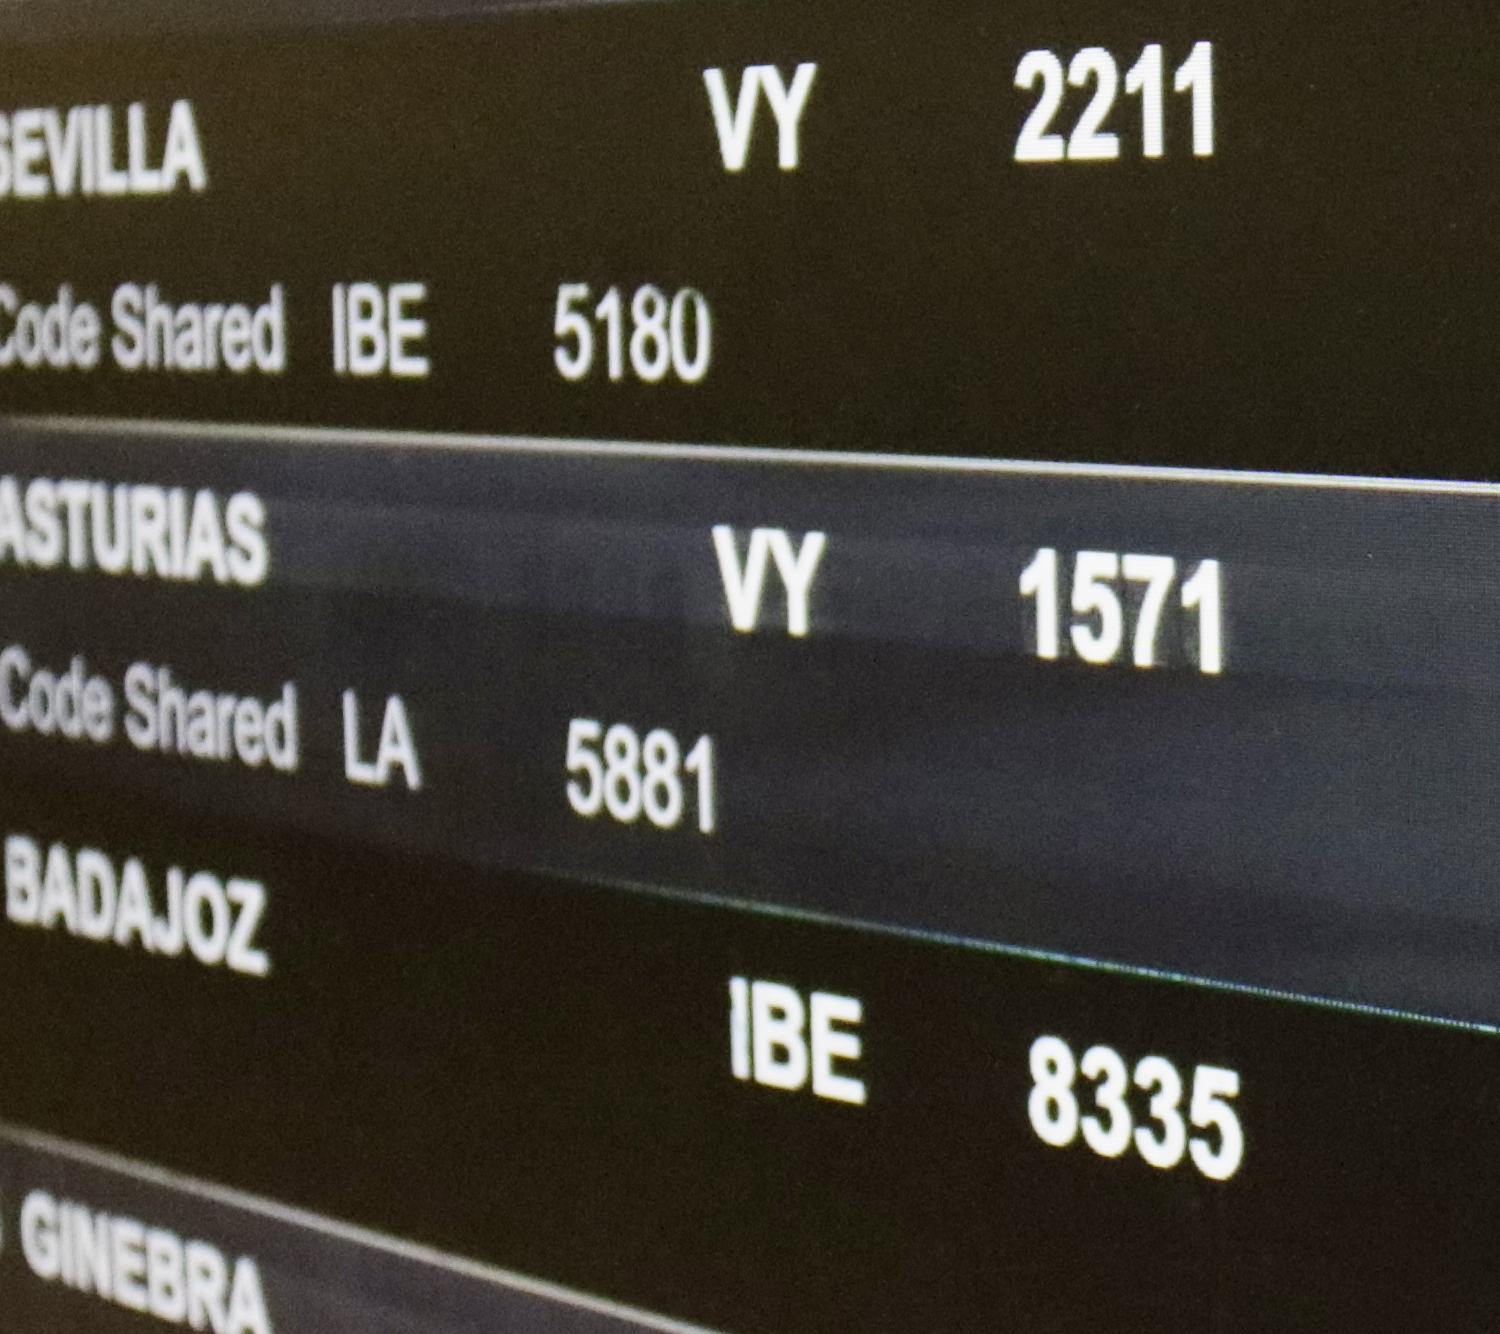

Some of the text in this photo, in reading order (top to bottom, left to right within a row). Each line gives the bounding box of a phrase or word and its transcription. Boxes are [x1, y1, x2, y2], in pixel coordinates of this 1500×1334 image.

[704, 63, 816, 171] VY
[1015, 41, 1213, 162] 2211
[112, 284, 285, 372] Shared
[333, 283, 428, 376] IBE
[555, 284, 710, 382] 5180
[712, 525, 826, 636] VY
[1020, 548, 1222, 674] 1571
[125, 663, 298, 770] Shared
[343, 691, 420, 788] LA
[567, 719, 714, 832] 5881
[6, 837, 268, 975] BADAJOZ
[730, 977, 865, 1104] IBE
[1028, 1036, 1243, 1180] 8335
